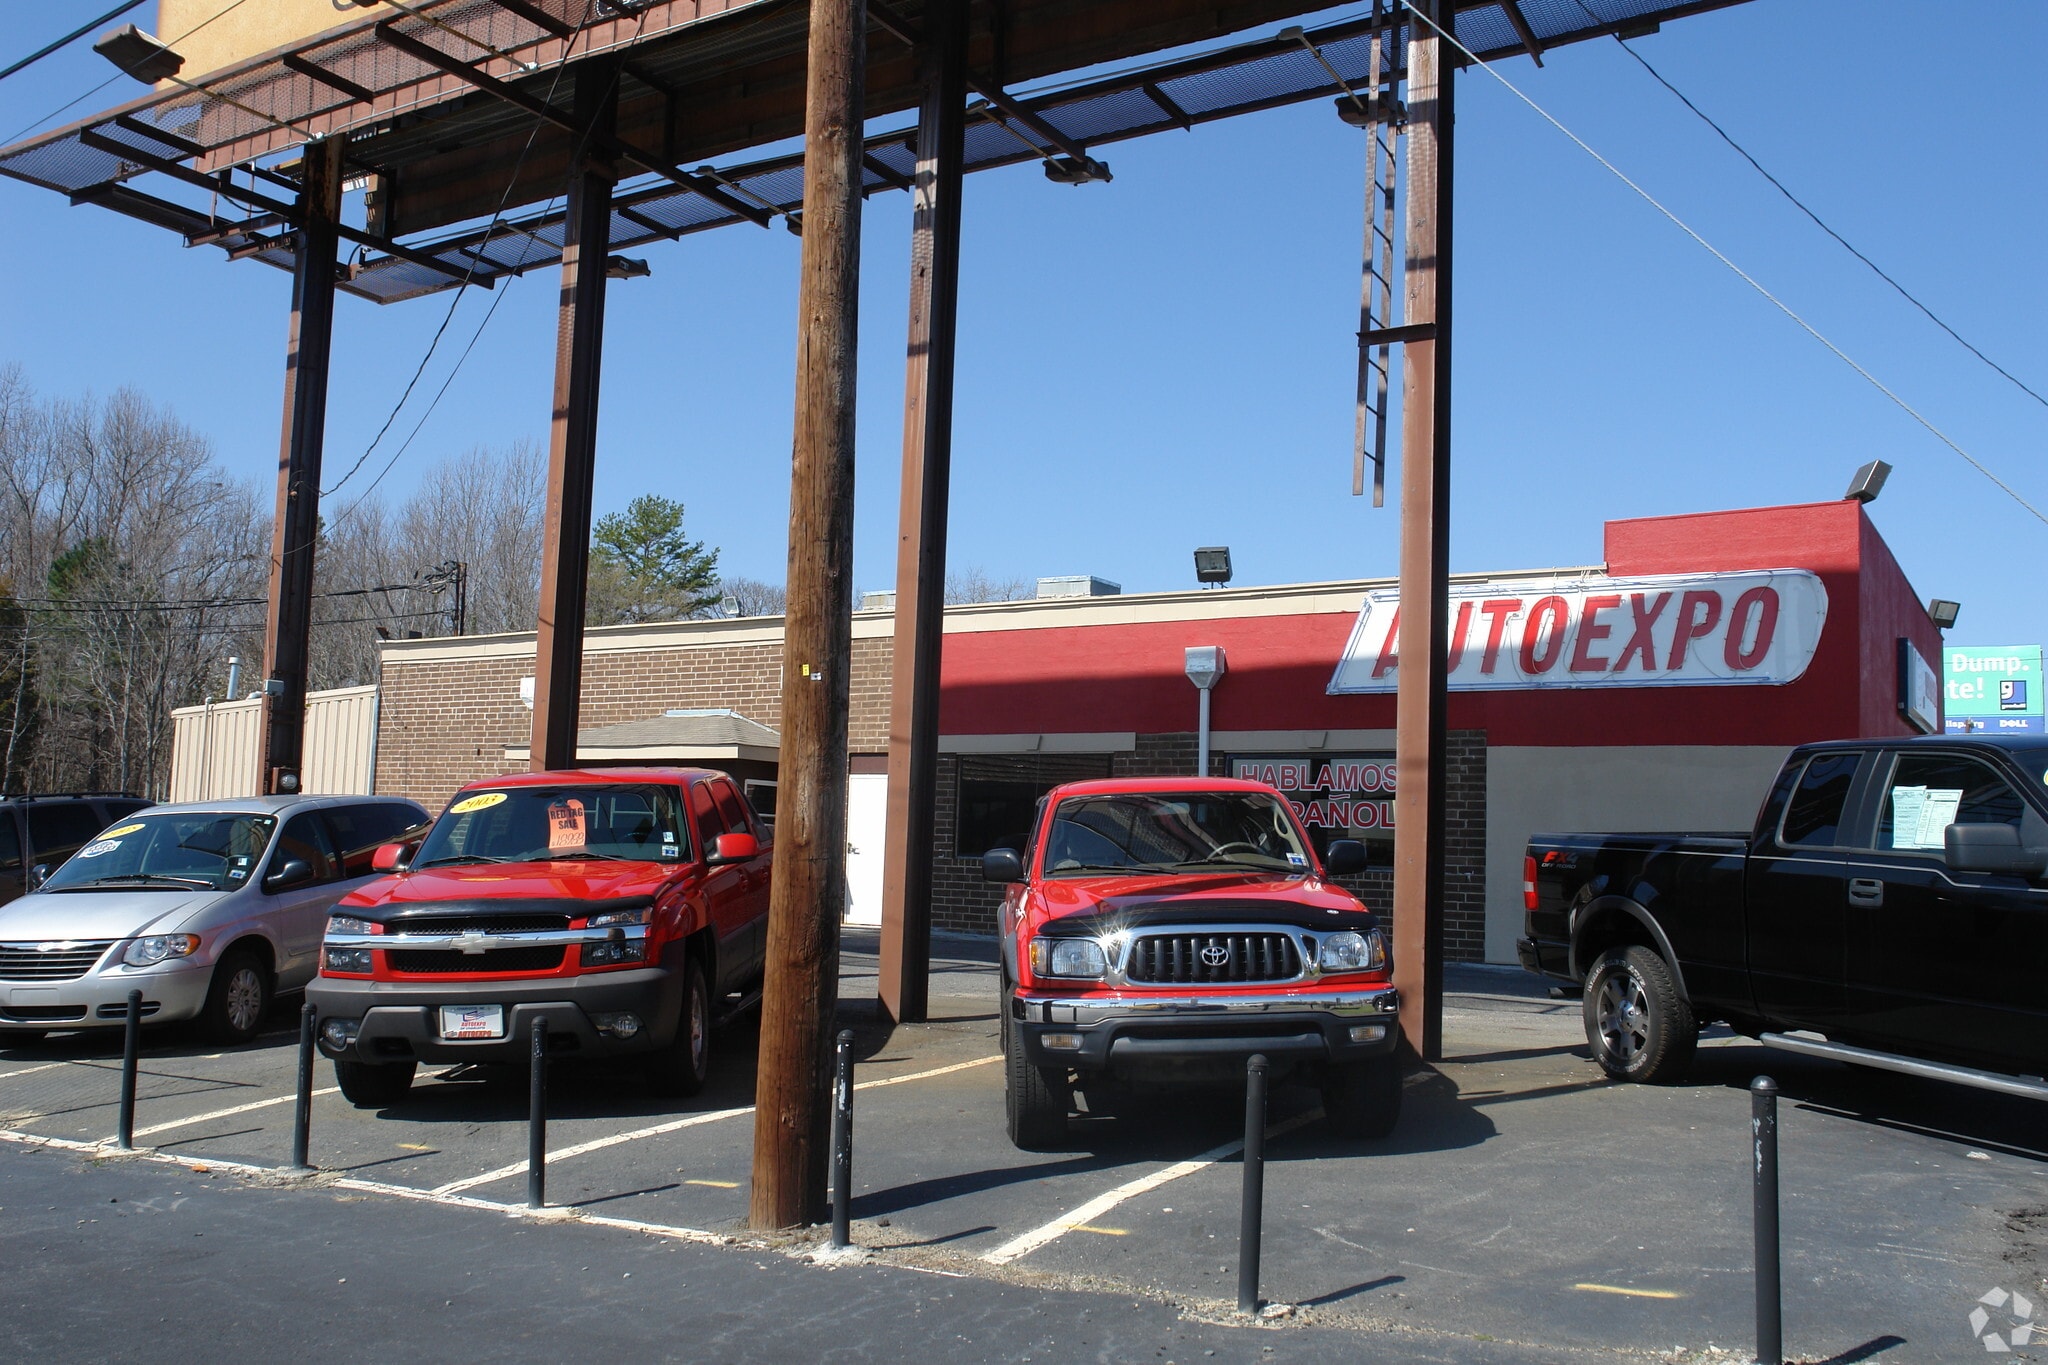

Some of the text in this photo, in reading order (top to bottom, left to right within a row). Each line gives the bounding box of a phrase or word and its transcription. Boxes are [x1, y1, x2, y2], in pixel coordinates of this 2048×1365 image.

[1952, 653, 2030, 676] Dump.
[1240, 764, 1397, 792] HABLAMOS
[550, 807, 583, 820] RED TAG
[558, 820, 579, 830] SALE
[1544, 851, 1579, 863] FX4
